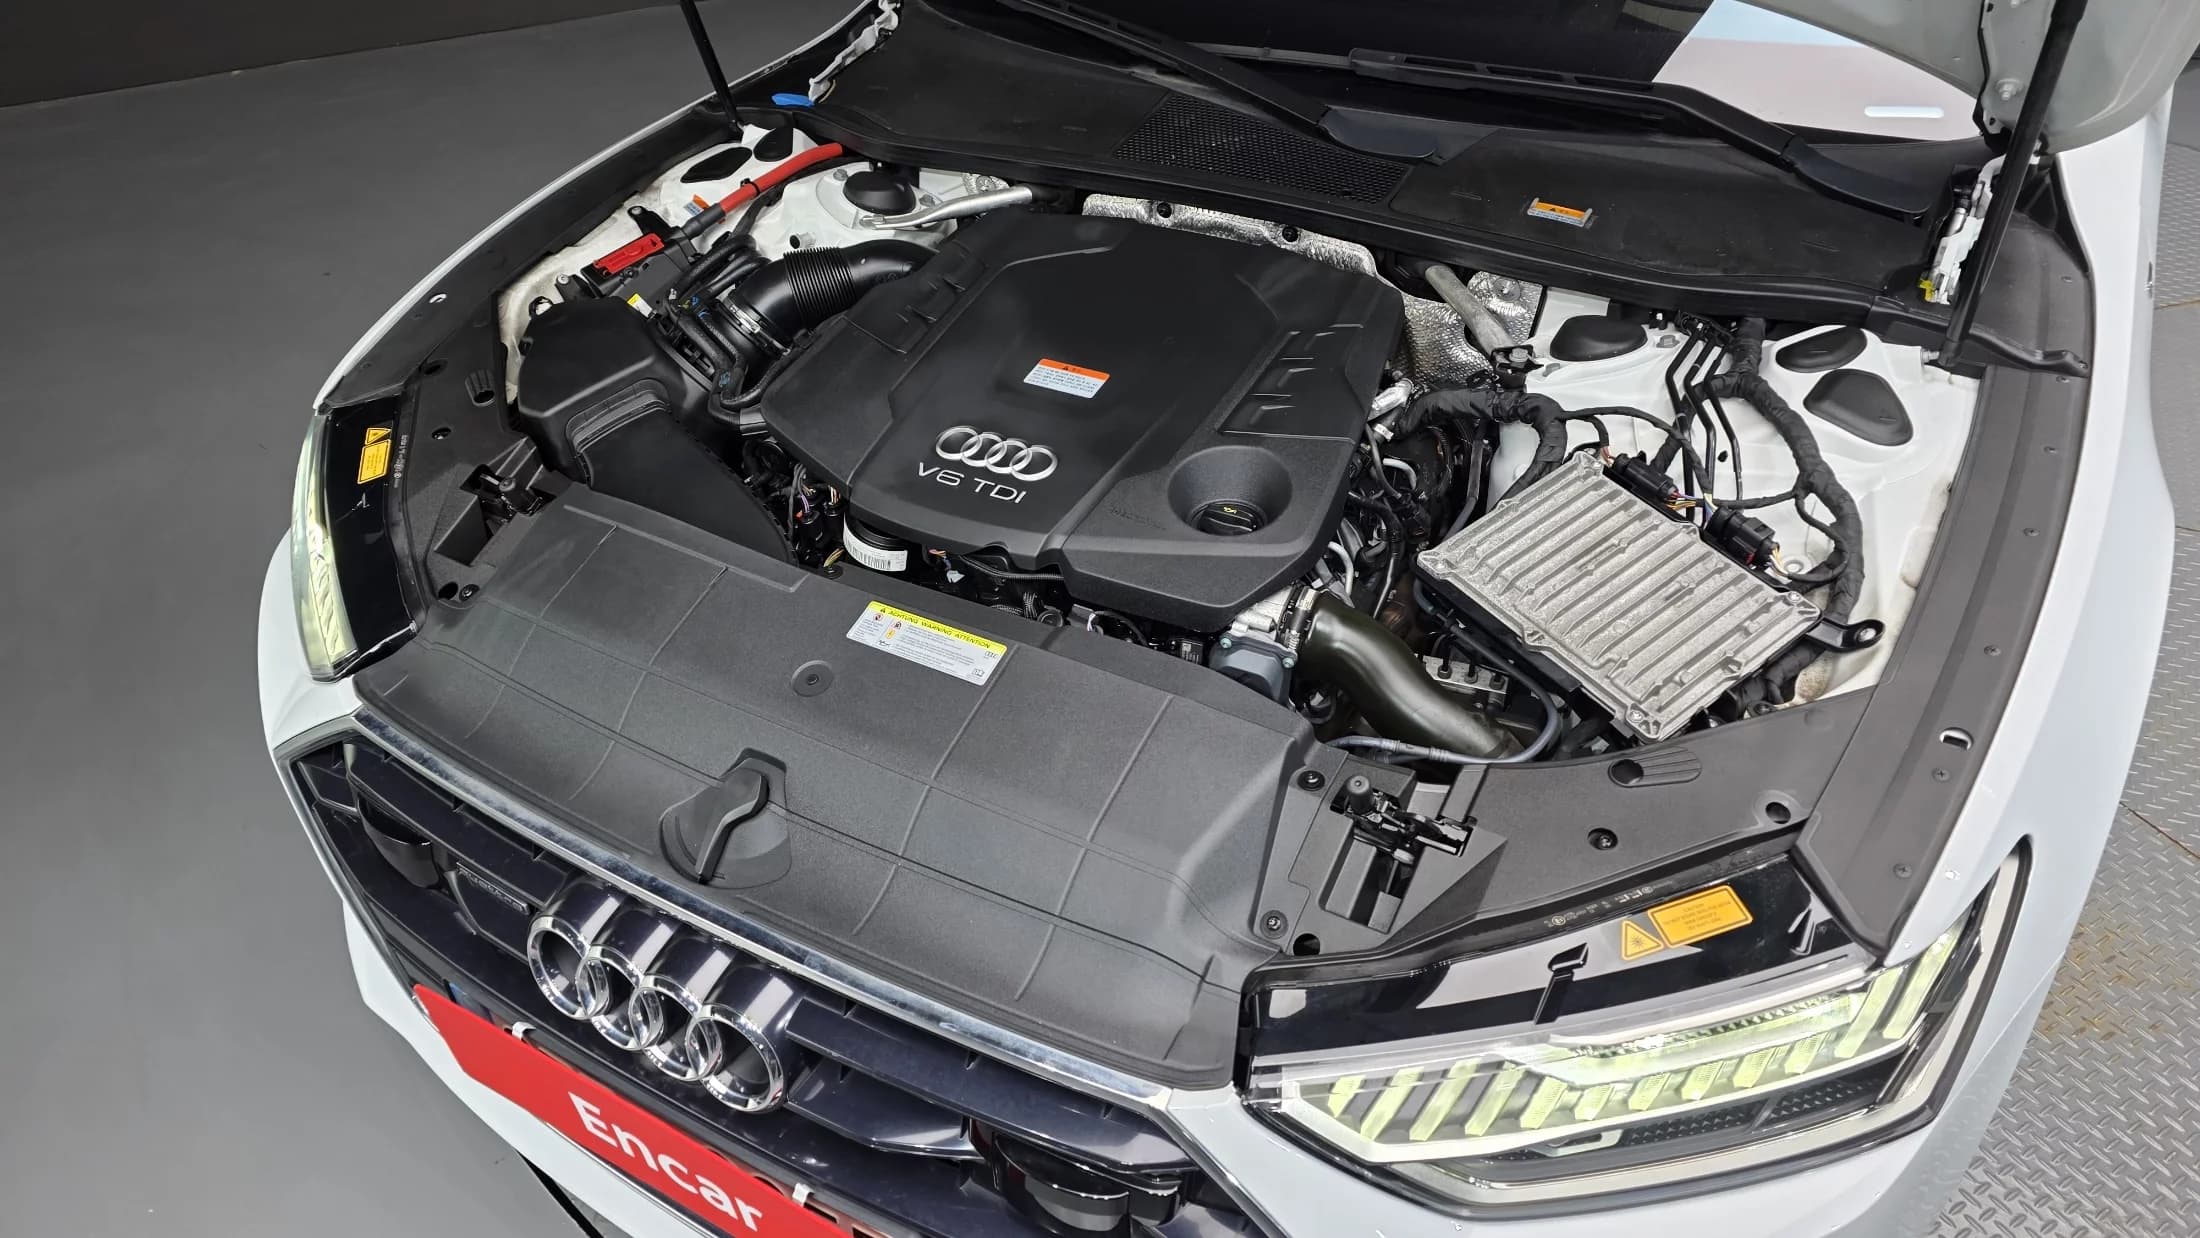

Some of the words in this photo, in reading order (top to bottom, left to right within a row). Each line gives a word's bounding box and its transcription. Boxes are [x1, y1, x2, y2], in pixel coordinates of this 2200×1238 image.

[917, 462, 965, 486] V6
[973, 477, 1027, 504] TDI
[888, 610, 918, 624] ACHTUNG
[921, 620, 952, 636] WARNING
[955, 631, 991, 649] ATTENTION
[568, 1091, 763, 1232] Encar
